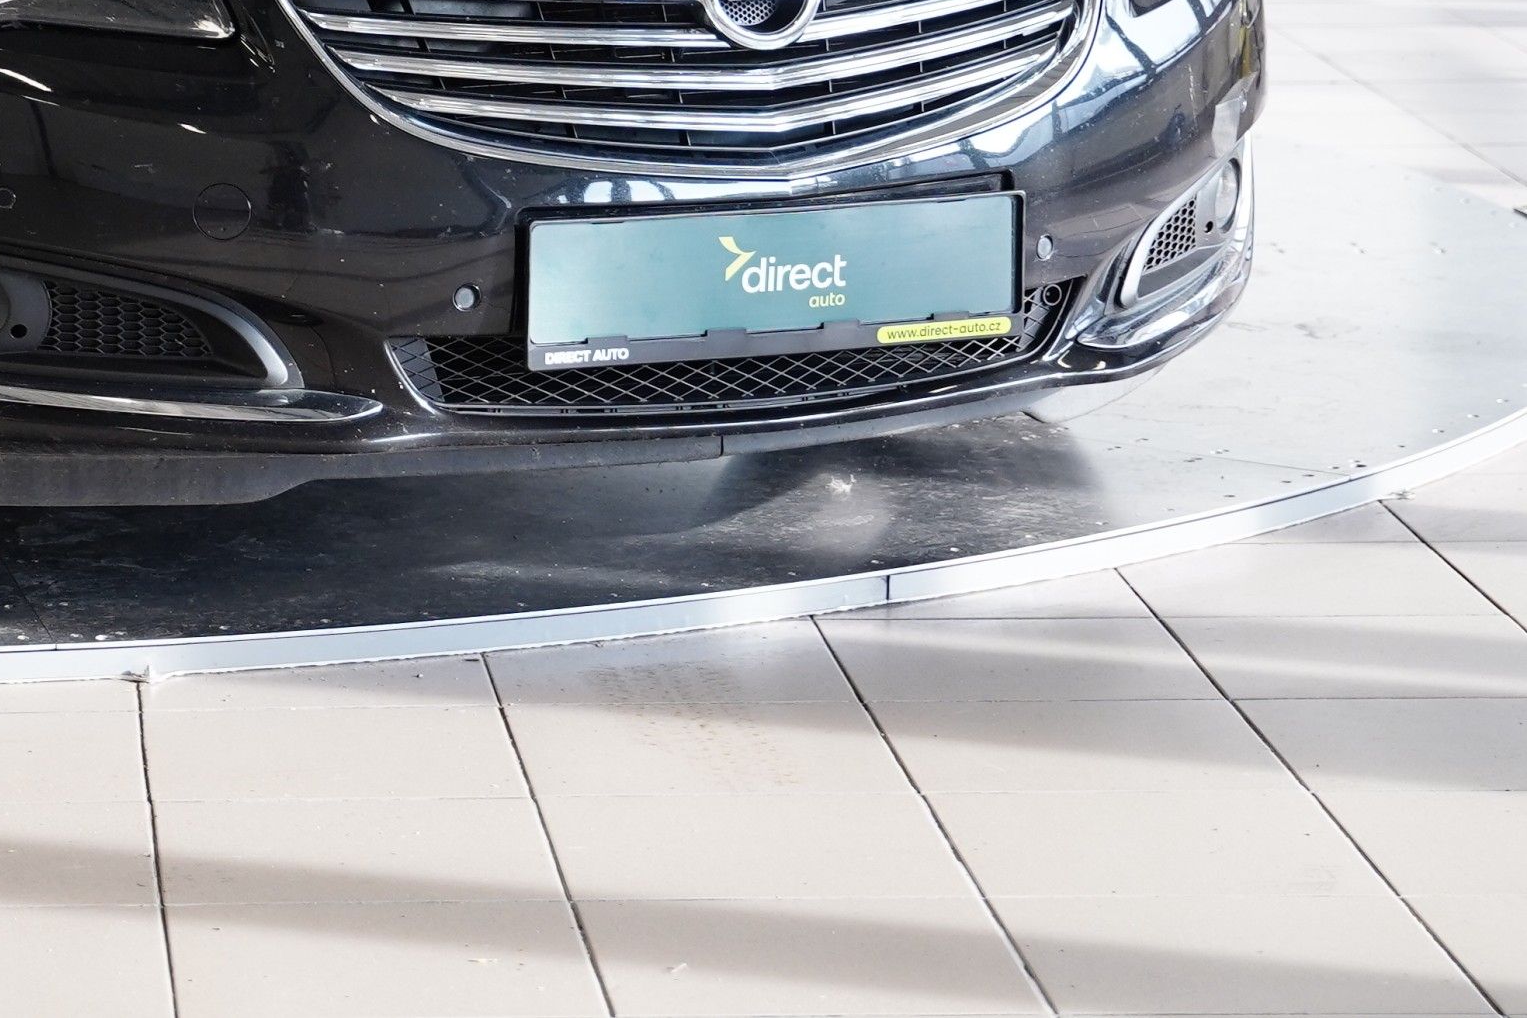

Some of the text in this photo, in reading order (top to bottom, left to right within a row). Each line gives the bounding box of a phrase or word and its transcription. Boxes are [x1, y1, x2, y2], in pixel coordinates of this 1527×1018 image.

[741, 254, 848, 294] direct
[808, 292, 846, 308] auto
[886, 322, 1002, 340] www.direct-auto.cz
[544, 348, 630, 365] DIRECT AUTO
